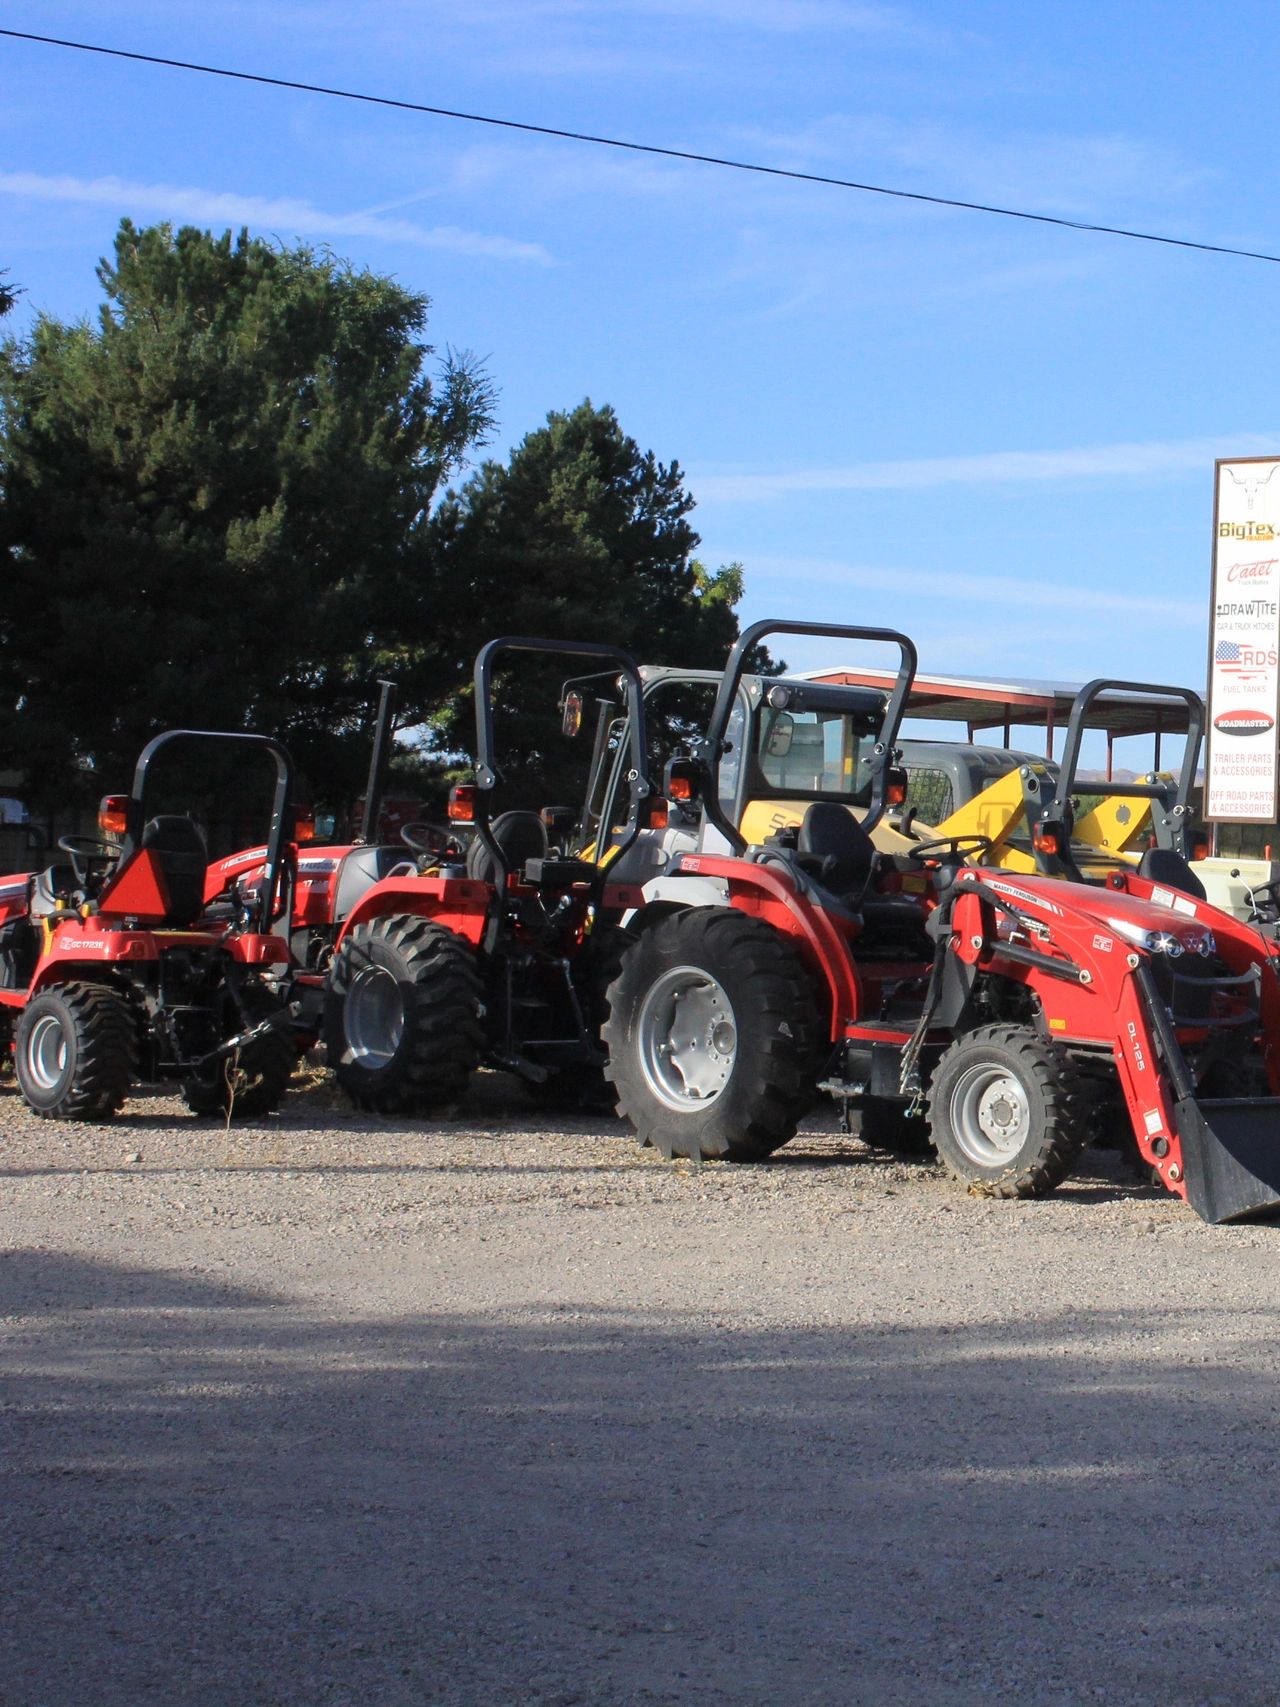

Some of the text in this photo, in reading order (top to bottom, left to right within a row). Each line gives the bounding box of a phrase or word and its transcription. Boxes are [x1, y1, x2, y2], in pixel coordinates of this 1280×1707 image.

[1227, 559, 1279, 583] Cadet
[1243, 650, 1278, 666] RDS
[1223, 685, 1267, 694] FUEL TANKS
[1218, 719, 1270, 728] ROADMASTER
[1214, 753, 1272, 764] TRAILER PARTS
[1220, 766, 1273, 777] ACCESSORIES
[1210, 790, 1274, 802] OFF ROAD PARTS
[1219, 803, 1272, 814] ACCESSORIES
[1127, 1022, 1145, 1071] DL125
